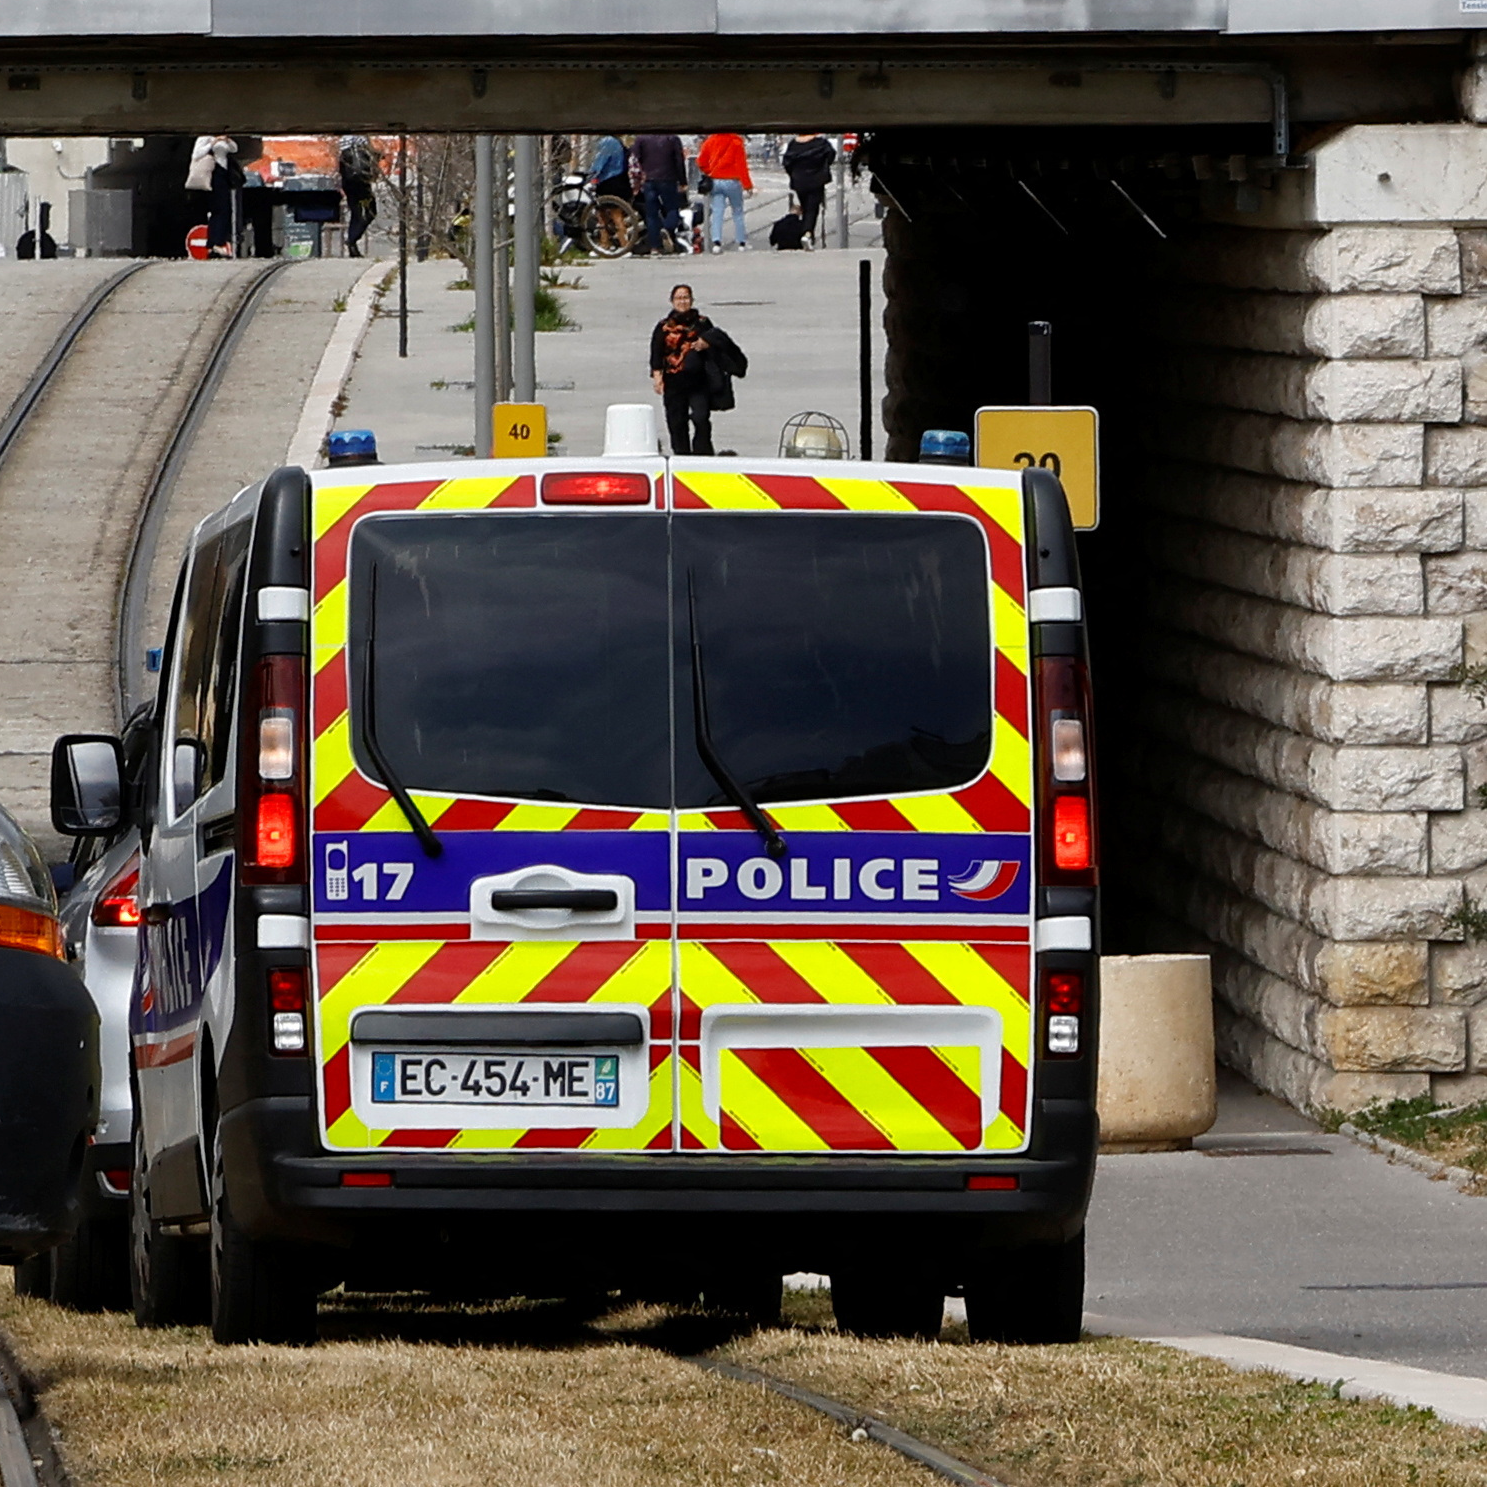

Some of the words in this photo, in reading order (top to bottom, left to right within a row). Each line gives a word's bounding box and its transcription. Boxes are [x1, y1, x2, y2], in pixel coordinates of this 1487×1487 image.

[508, 422, 531, 441] 40
[352, 863, 414, 900] 17
[686, 857, 940, 902] POLICE
[379, 1081, 389, 1093] F
[399, 1059, 589, 1098] EC-454-ME
[595, 1083, 616, 1101] 87
